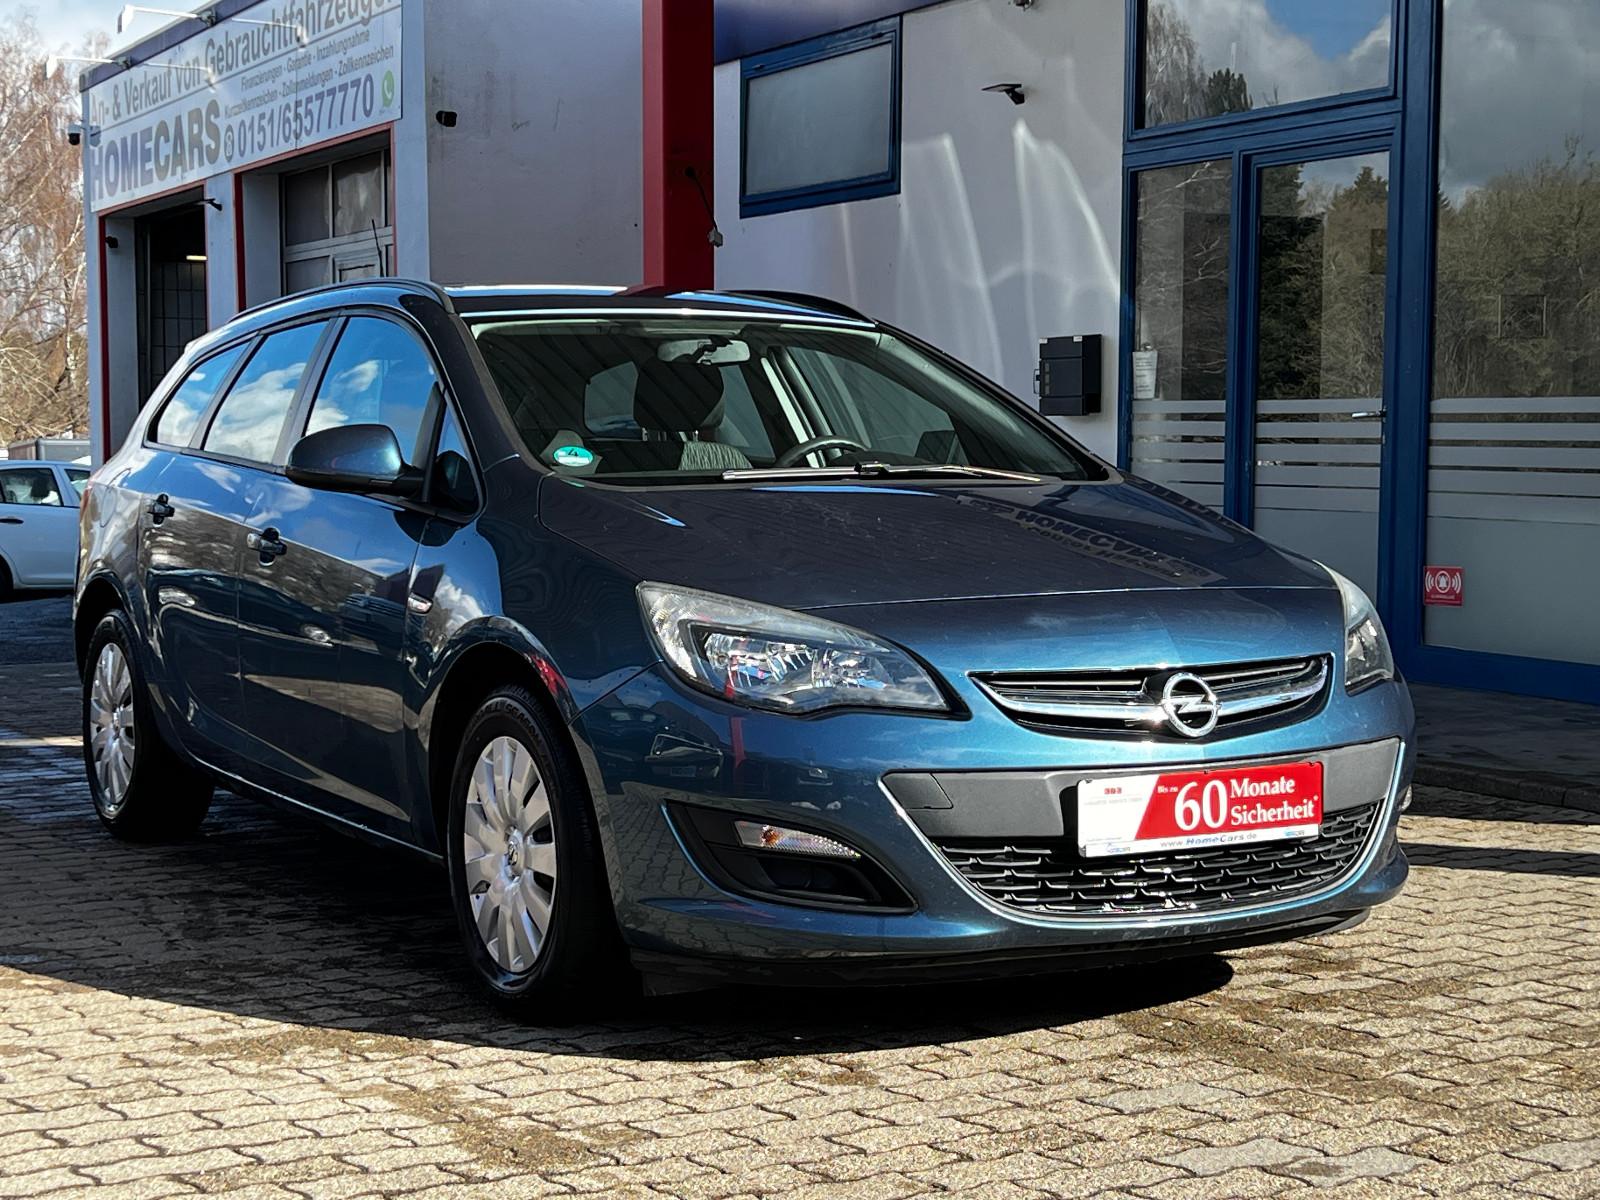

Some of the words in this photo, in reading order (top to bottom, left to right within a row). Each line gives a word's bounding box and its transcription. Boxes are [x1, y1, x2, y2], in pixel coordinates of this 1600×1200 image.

[112, 84, 121, 121] &
[124, 59, 172, 115] Verkauf
[176, 56, 200, 93] von
[205, 0, 390, 76] Gebrauchtfahrzeug
[90, 98, 221, 199] HOMECARS
[238, 73, 374, 157] 0151/65577770
[1175, 779, 1228, 831] 60
[1230, 776, 1296, 798] Monate
